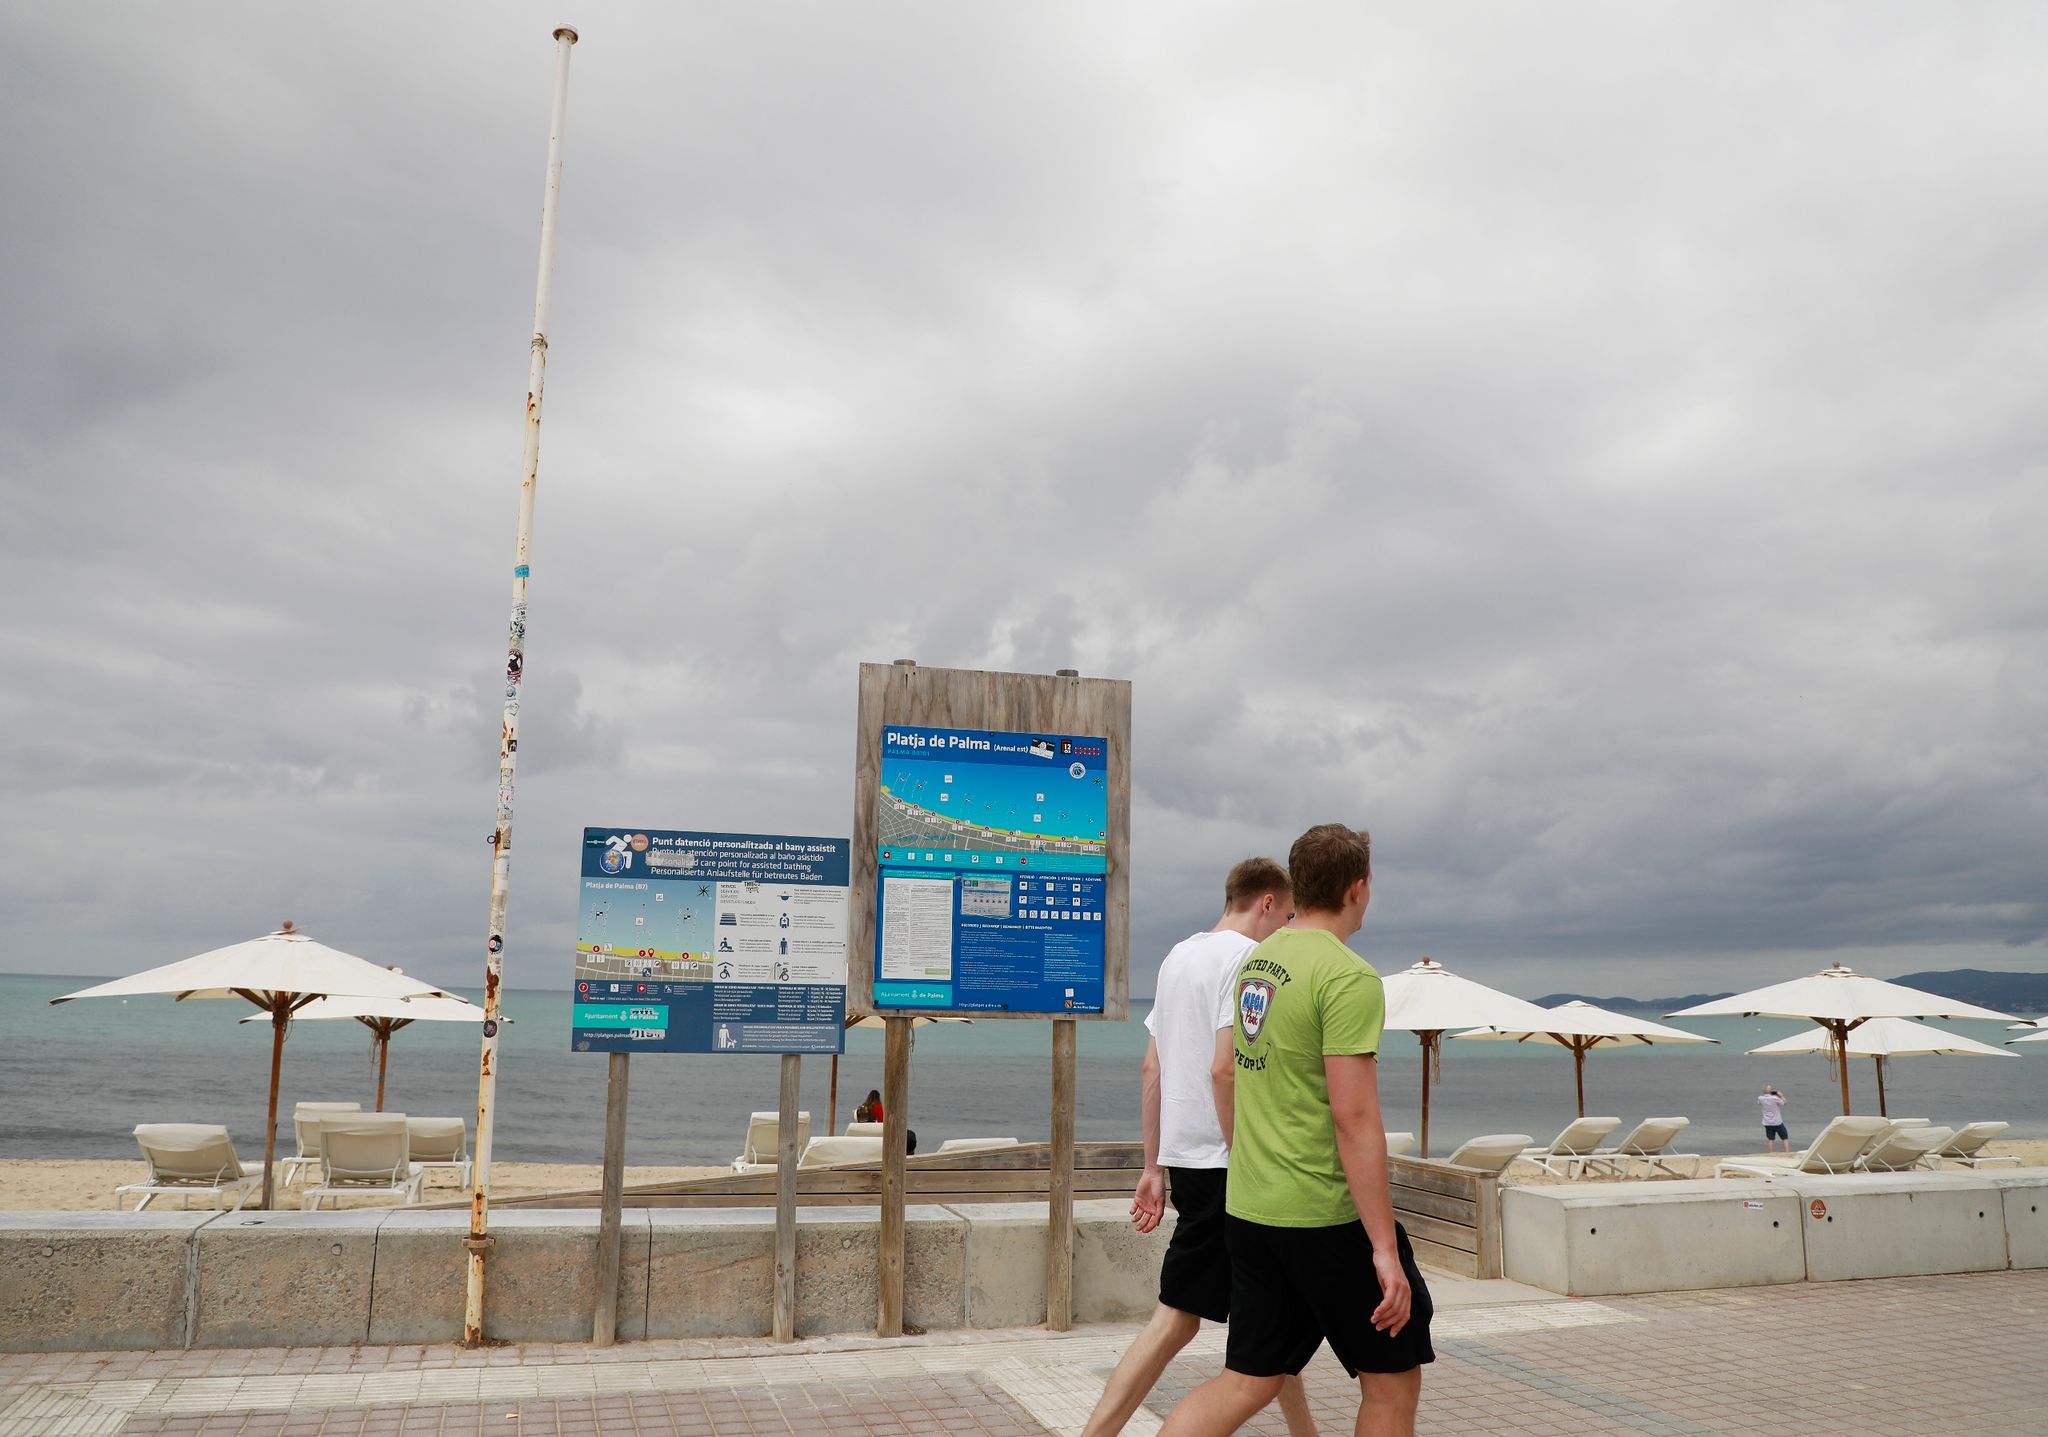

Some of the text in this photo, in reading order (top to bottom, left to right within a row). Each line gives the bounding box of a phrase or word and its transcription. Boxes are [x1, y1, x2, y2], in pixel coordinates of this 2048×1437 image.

[886, 732, 926, 749] Platja
[928, 735, 946, 748] de
[949, 736, 990, 751] Palma
[993, 744, 1016, 752] (Arenal
[1017, 745, 1029, 754] est)
[652, 837, 673, 847] Punt
[675, 838, 711, 848] datenció
[712, 840, 774, 851] personalitzada
[775, 842, 783, 850] al
[785, 843, 805, 853] bany
[807, 844, 837, 853] assistit
[675, 848, 687, 856] de
[687, 849, 718, 858] atención
[719, 851, 769, 861] personalizada
[770, 852, 777, 860] al
[777, 852, 796, 861] baño
[797, 853, 824, 862] asistido
[701, 860, 717, 868] care
[718, 860, 737, 869] point
[739, 860, 750, 869] for
[752, 861, 782, 870] assisted
[783, 862, 812, 872] bathing
[651, 867, 823, 881] Personalisierte Anlaufstelle für betreutes Baden
[585, 881, 604, 889] Platja
[1266, 961, 1292, 987] PARTY
[584, 1012, 618, 1021] Ajuntament
